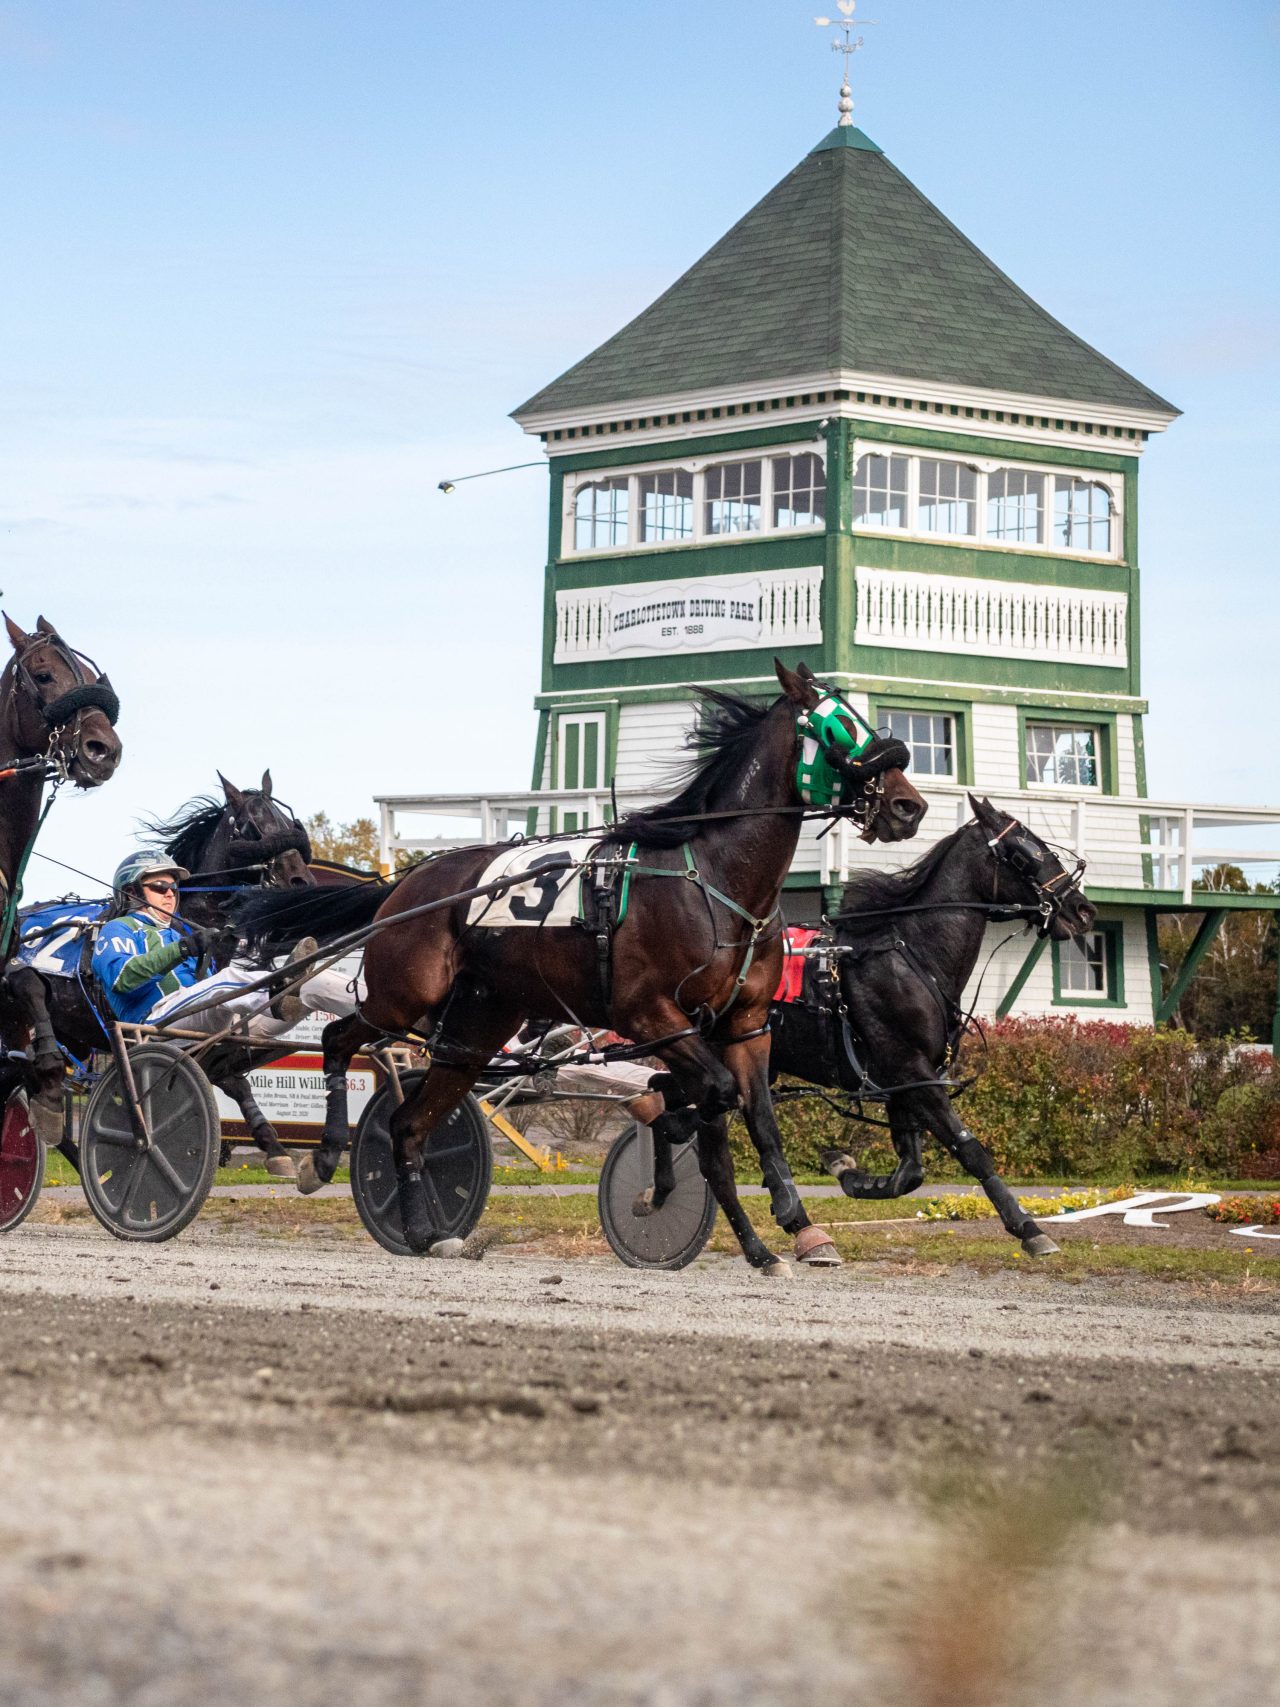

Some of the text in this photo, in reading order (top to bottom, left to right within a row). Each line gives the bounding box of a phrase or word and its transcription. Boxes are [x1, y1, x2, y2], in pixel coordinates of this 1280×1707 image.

[613, 599, 754, 632] CHARLOTTETOWN DRIVING PARK
[661, 625, 704, 636] EST. 1888
[508, 851, 572, 921] 3
[32, 915, 88, 971] 2
[250, 1075, 273, 1088] Mile
[276, 1076, 296, 1089] Hill
